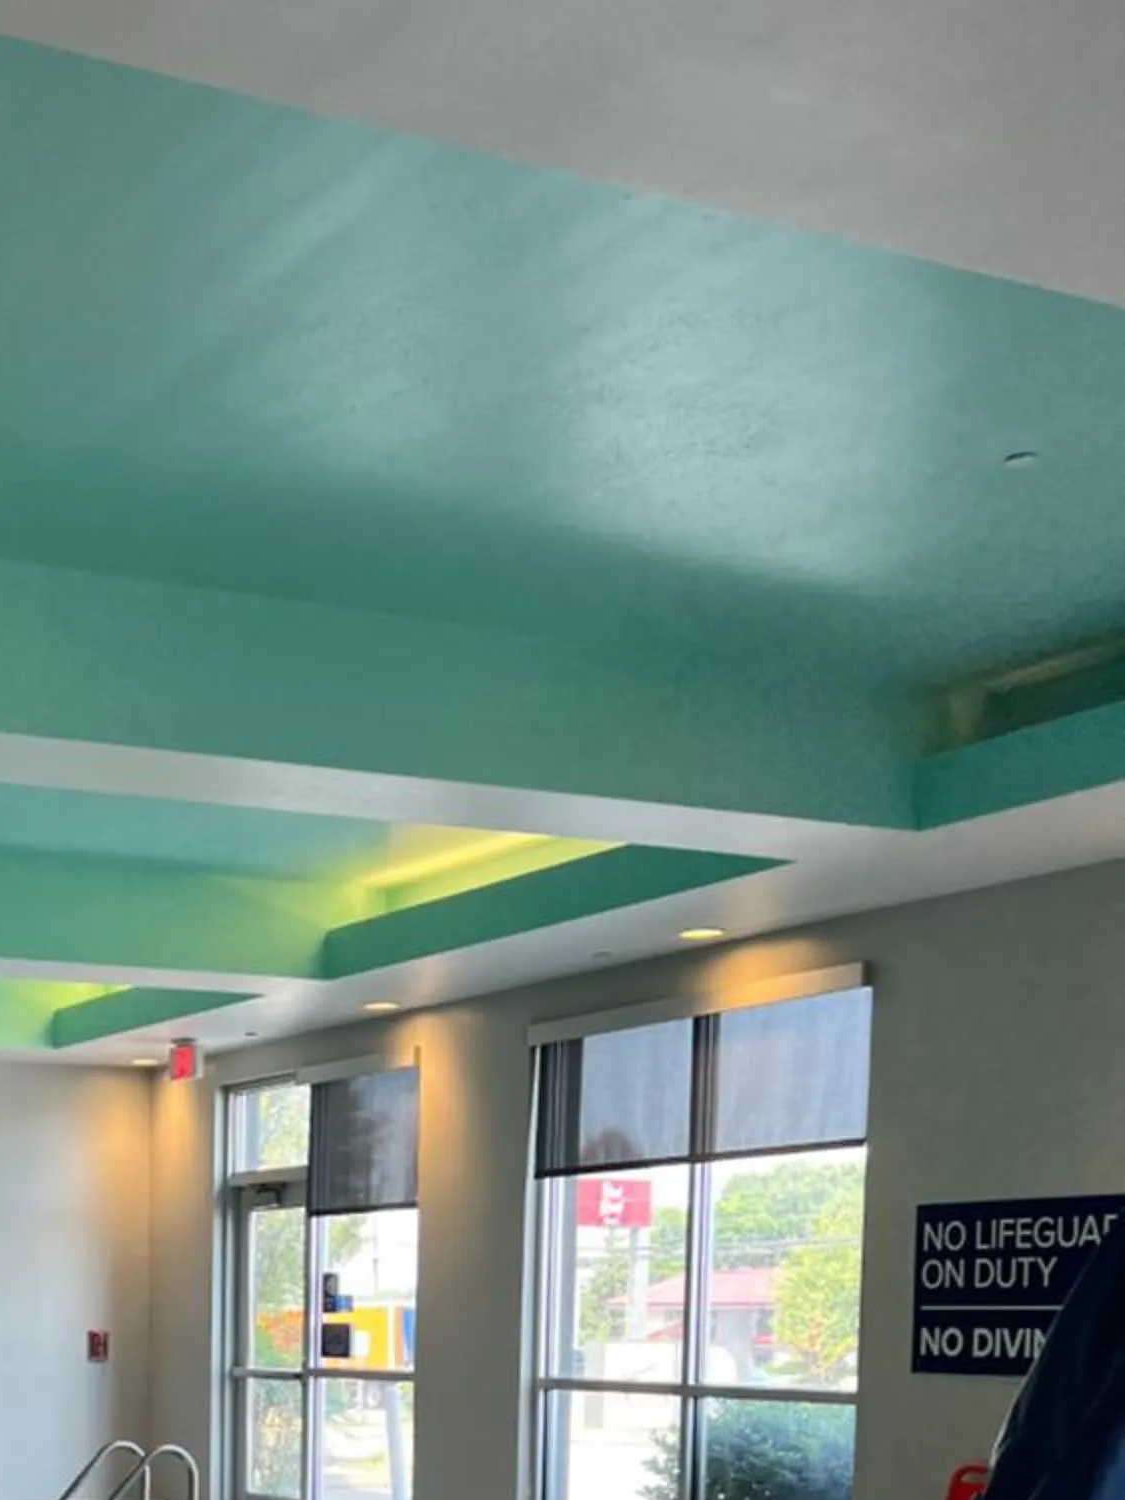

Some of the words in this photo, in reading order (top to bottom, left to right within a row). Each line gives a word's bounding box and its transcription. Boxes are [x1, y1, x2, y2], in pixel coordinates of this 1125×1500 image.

[923, 1221, 966, 1252] NO
[922, 1258, 965, 1290] ON
[975, 1256, 1058, 1289] DUTY
[920, 1326, 964, 1357] NO
